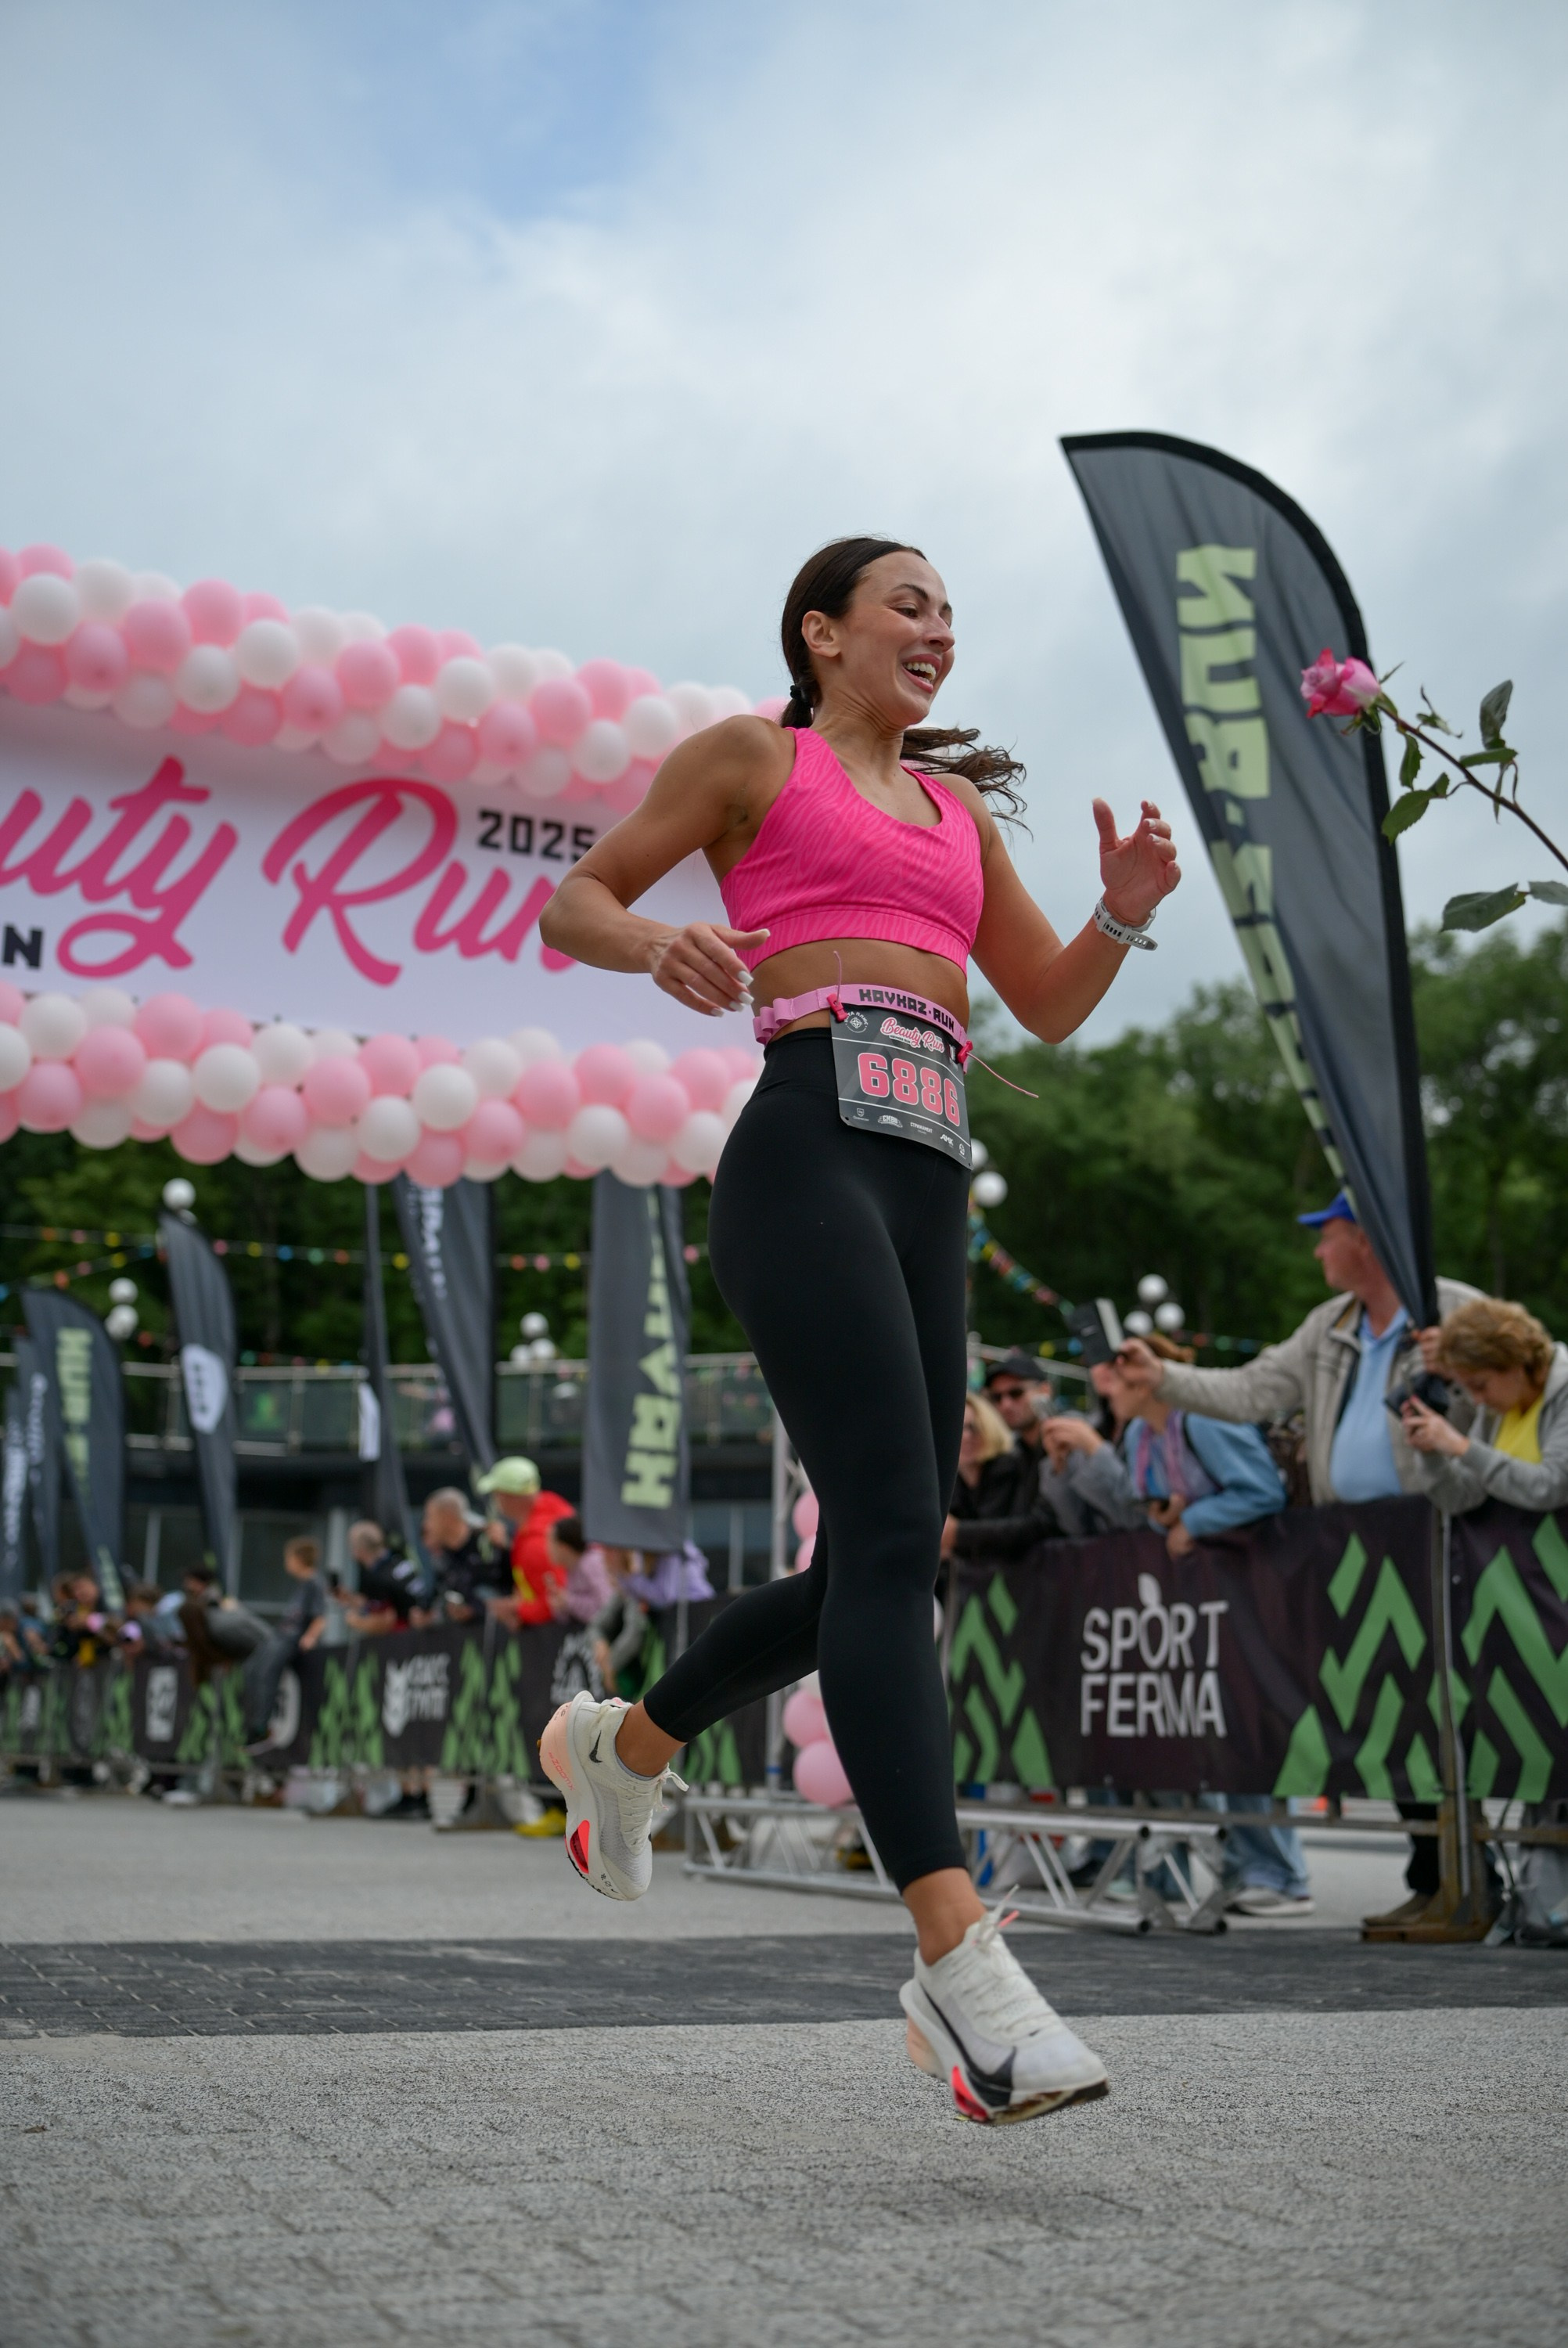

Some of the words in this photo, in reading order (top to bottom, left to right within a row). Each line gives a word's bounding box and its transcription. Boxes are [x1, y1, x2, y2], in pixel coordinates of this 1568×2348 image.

[0, 754, 239, 978] uty
[477, 809, 597, 864] 2025
[2, 924, 43, 970] N
[879, 1017, 921, 1049] Beauty
[922, 1030, 945, 1053] Run
[858, 1053, 960, 1127] 6886
[1081, 1601, 1228, 1670] SPORT
[1081, 1670, 1227, 1738] FERMA
